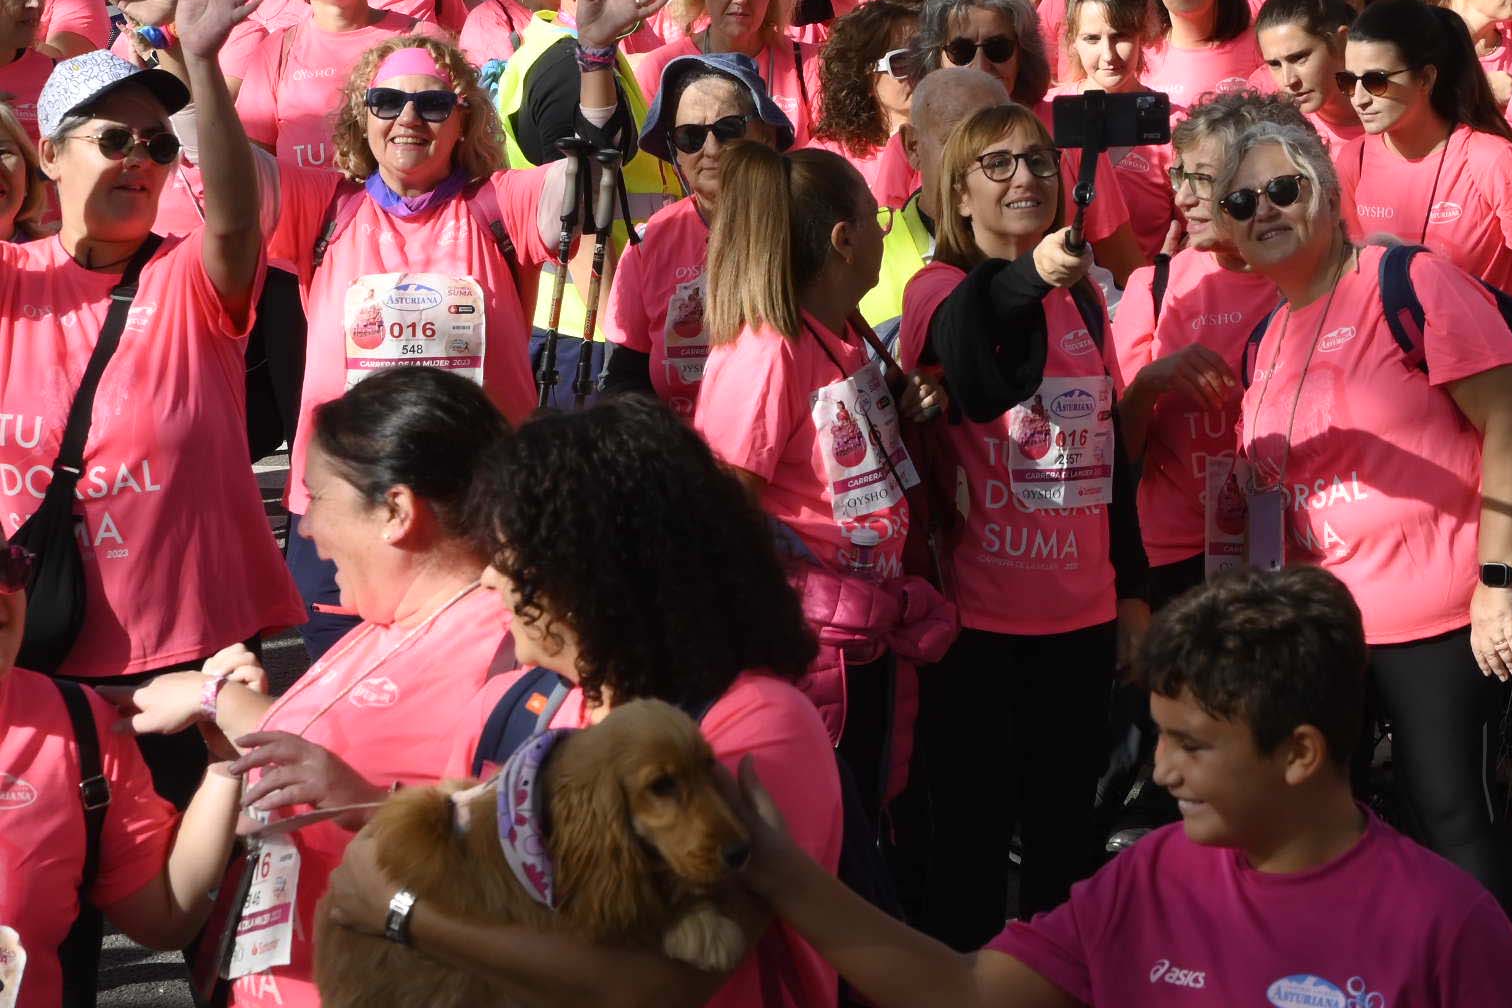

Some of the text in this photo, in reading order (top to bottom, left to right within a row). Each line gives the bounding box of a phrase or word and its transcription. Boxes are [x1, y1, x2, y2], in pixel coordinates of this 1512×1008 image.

[293, 142, 326, 168] TU
[387, 294, 438, 305] ASTURIANA
[389, 321, 437, 339] 016
[1192, 311, 1243, 331] OYSHO
[401, 344, 424, 355] 548
[847, 487, 889, 509] OYSHO
[982, 522, 1079, 560] SUMA
[1165, 967, 1206, 988] asics
